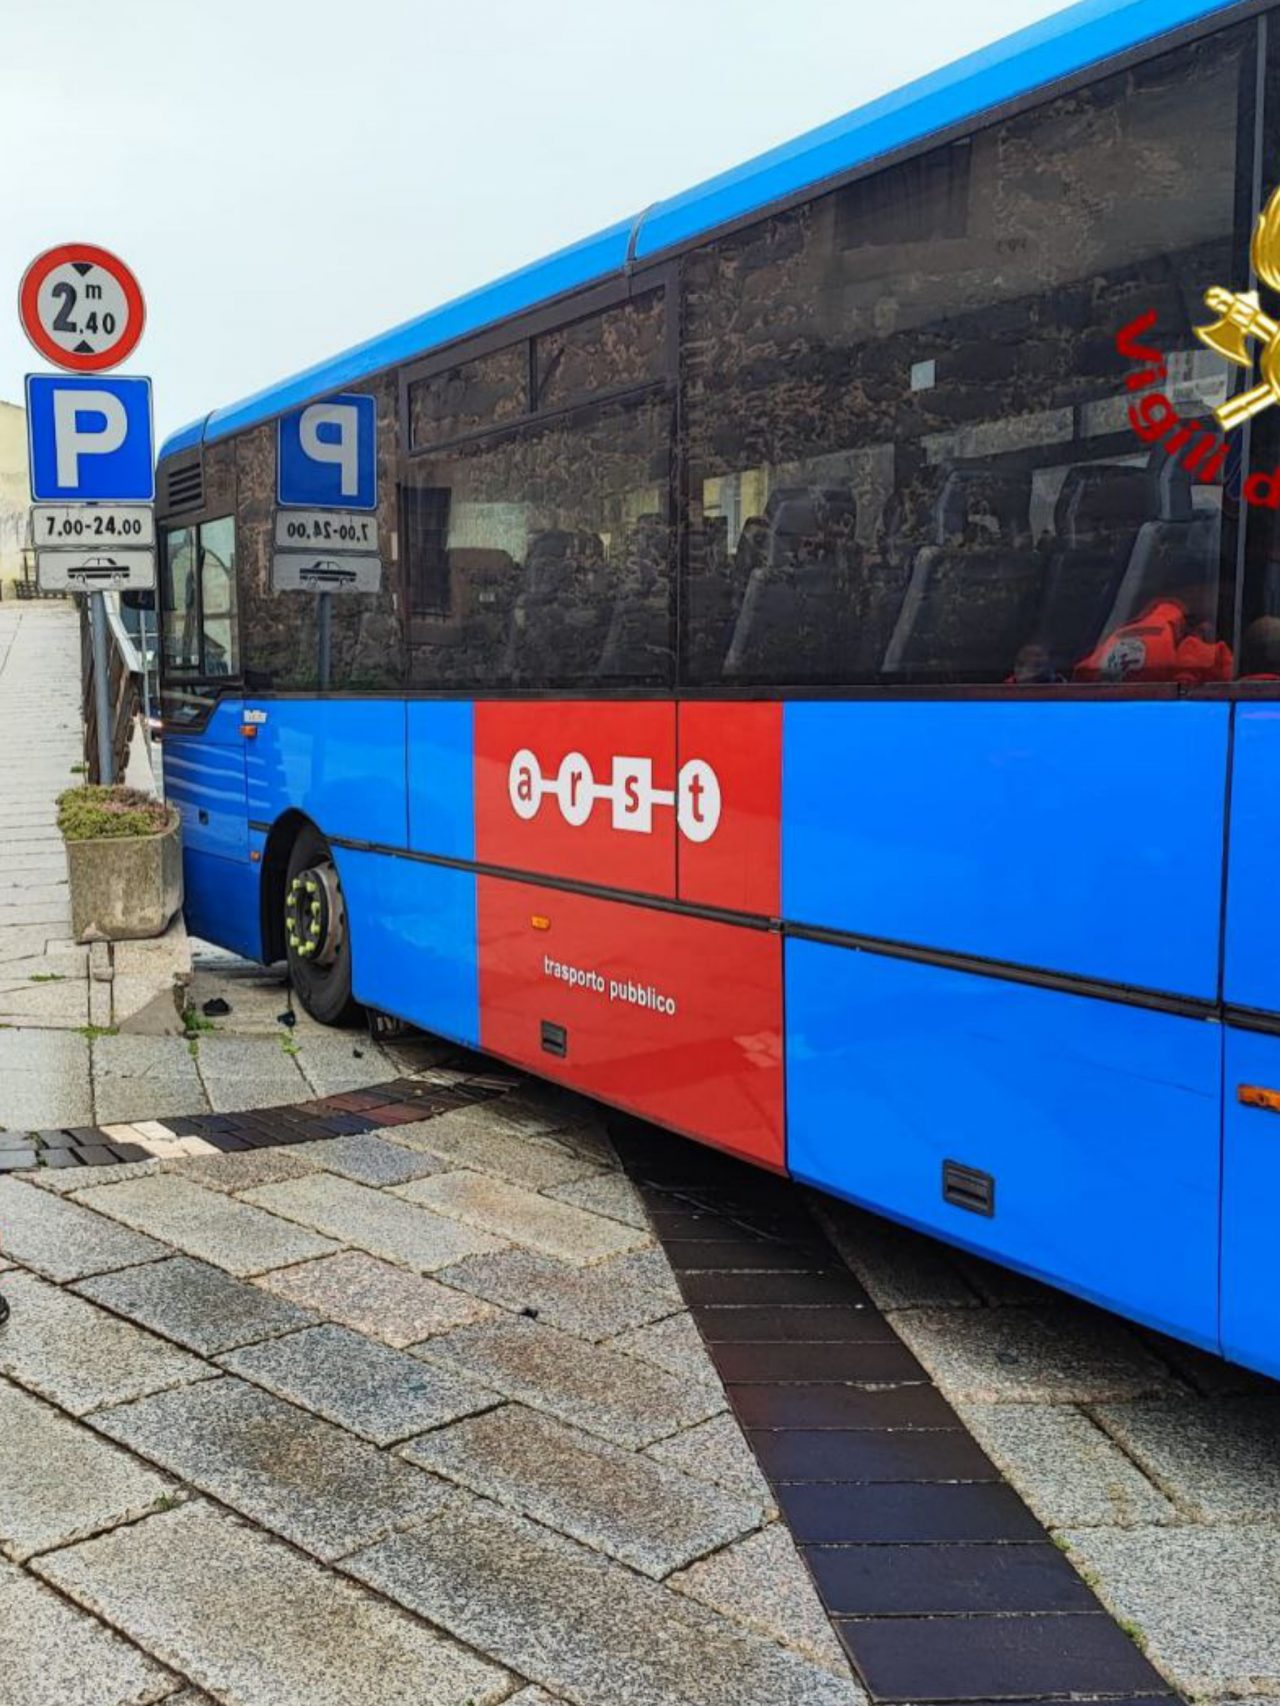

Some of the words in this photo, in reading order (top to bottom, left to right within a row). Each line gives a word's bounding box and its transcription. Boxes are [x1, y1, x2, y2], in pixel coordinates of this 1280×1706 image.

[85, 284, 103, 300] m
[53, 389, 128, 488] P
[46, 516, 142, 537] 7.00-24.00
[515, 762, 708, 826] arst
[544, 955, 606, 993] trasporto
[609, 979, 676, 1015] pubblico
